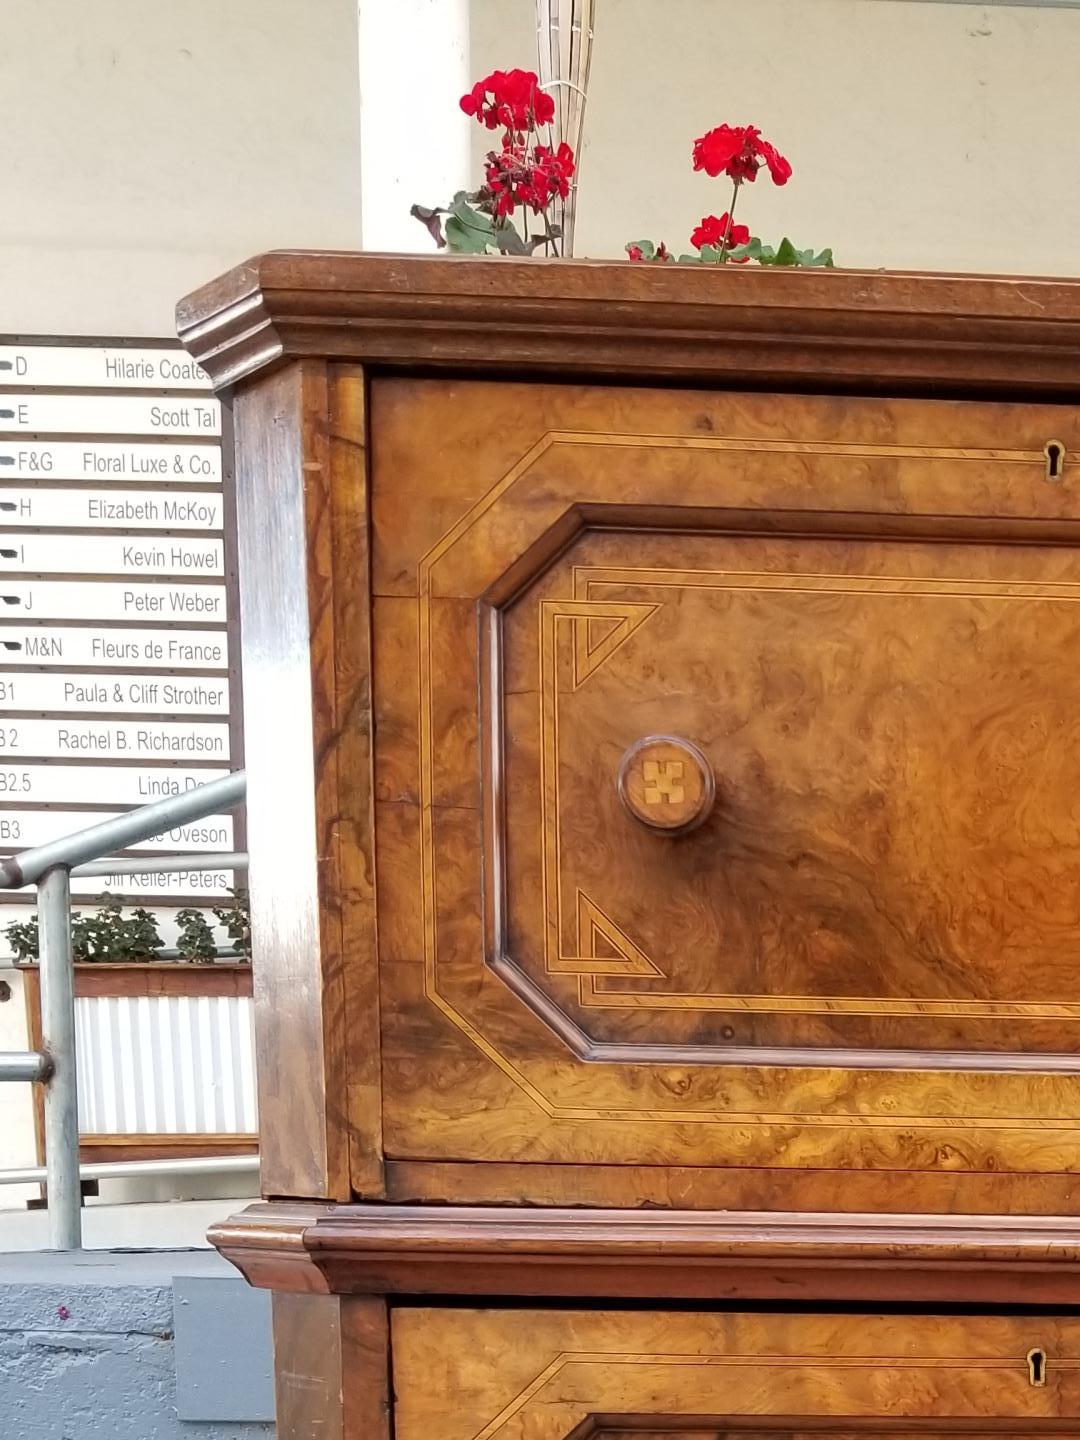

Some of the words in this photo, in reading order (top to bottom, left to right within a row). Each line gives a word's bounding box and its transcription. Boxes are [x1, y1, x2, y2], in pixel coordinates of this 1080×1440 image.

[16, 356, 27, 376] D
[105, 358, 155, 379] Hilarie
[18, 404, 29, 424] E
[150, 406, 190, 428] Scott
[194, 407, 216, 428] Tal
[18, 451, 53, 471] F&G
[83, 452, 125, 473] Floral
[131, 454, 168, 473] Luxe
[173, 454, 184, 474] &
[189, 455, 216, 475] Co.
[20, 498, 32, 517] H
[88, 499, 158, 520] Elizabeth
[164, 500, 216, 527] McKoy
[123, 546, 166, 567] Kevin
[171, 548, 218, 569] Howel
[24, 591, 33, 611] J
[124, 591, 165, 611] Peter
[169, 592, 220, 612] Weber
[25, 637, 63, 657] M&N
[92, 638, 139, 659] Fleurs
[144, 640, 163, 660] de
[168, 640, 221, 661] France
[64, 682, 107, 703] Paula
[113, 683, 124, 704] &
[129, 684, 158, 704] Cliff
[163, 685, 223, 706] Strother
[58, 730, 111, 750] Rachel
[116, 731, 131, 750] B.
[137, 731, 223, 751] Richardson
[138, 776, 179, 796] Linda
[1, 820, 21, 840] B3
[169, 826, 228, 843] Oveson
[129, 871, 227, 888] Keller-Peters
